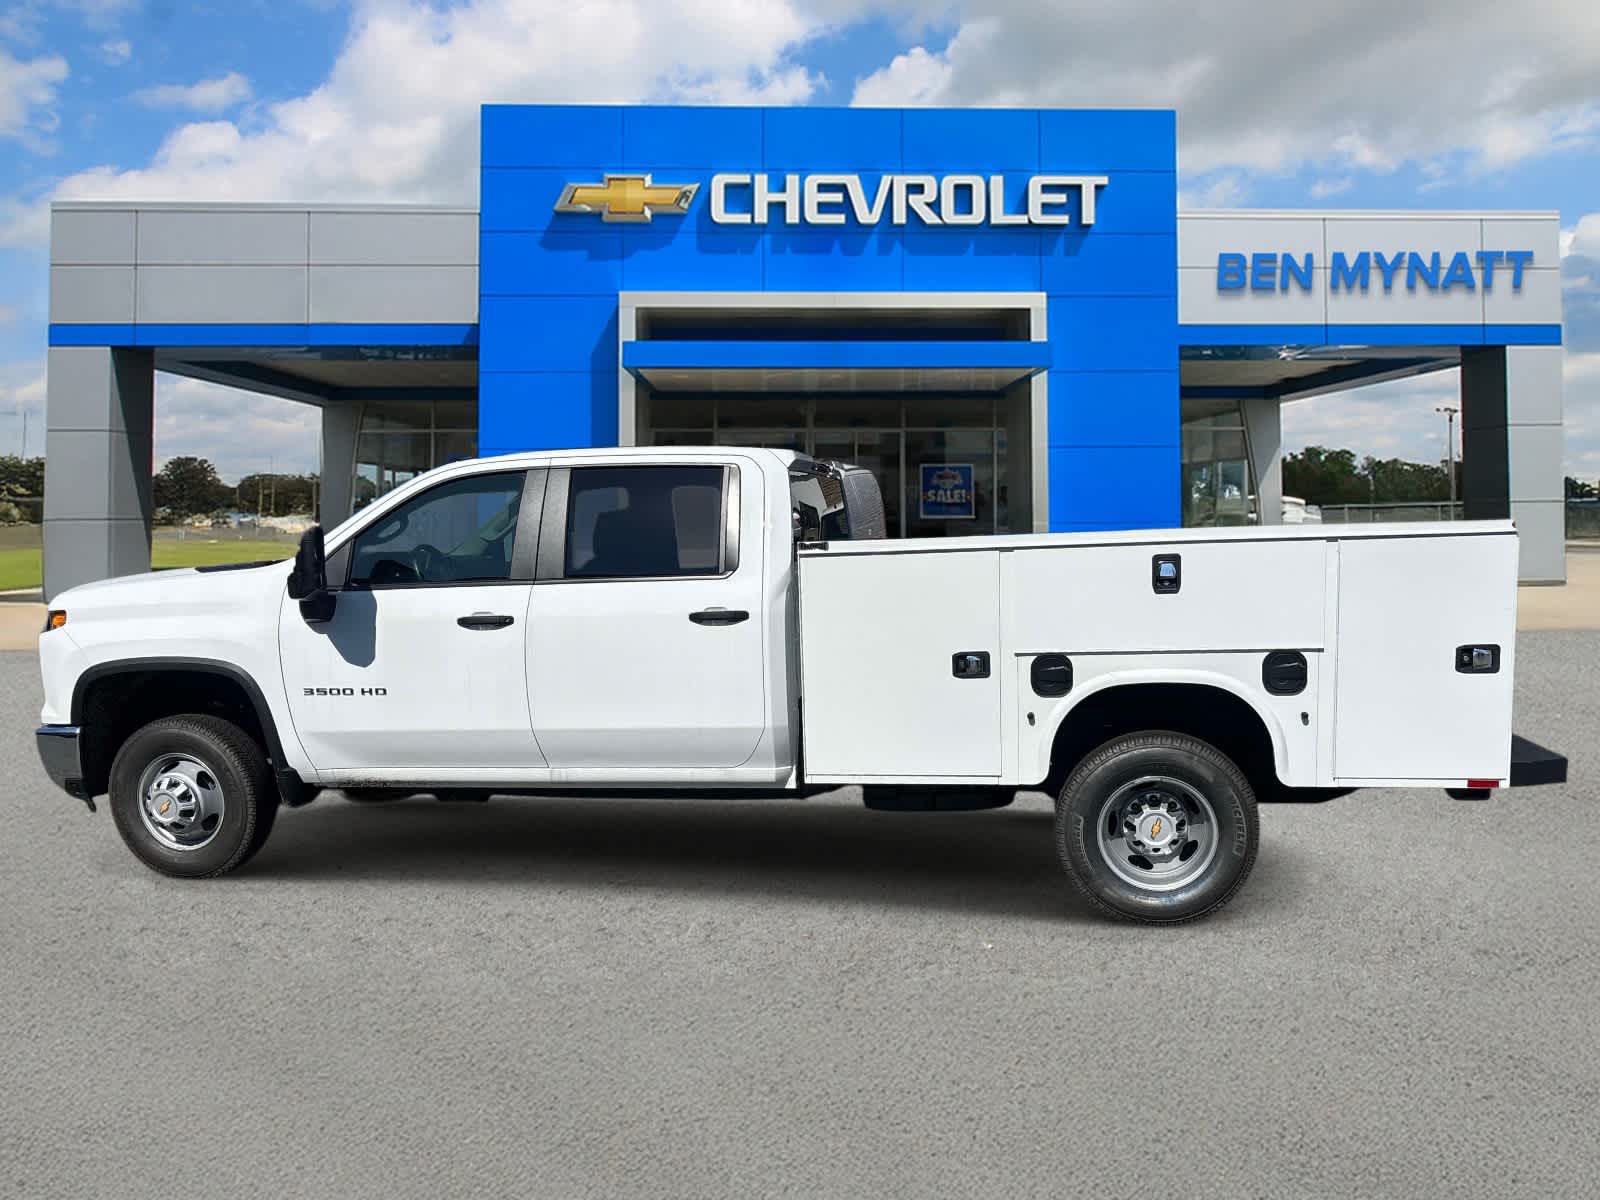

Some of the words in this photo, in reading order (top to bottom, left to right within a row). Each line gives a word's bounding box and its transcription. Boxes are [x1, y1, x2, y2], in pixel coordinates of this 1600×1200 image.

[710, 173, 1109, 225] CHEVROLET
[1217, 252, 1314, 290] BEN
[1330, 250, 1534, 290] MYNATT
[927, 489, 966, 503] SALE!
[303, 687, 355, 696] 3500
[361, 687, 387, 696] HD
